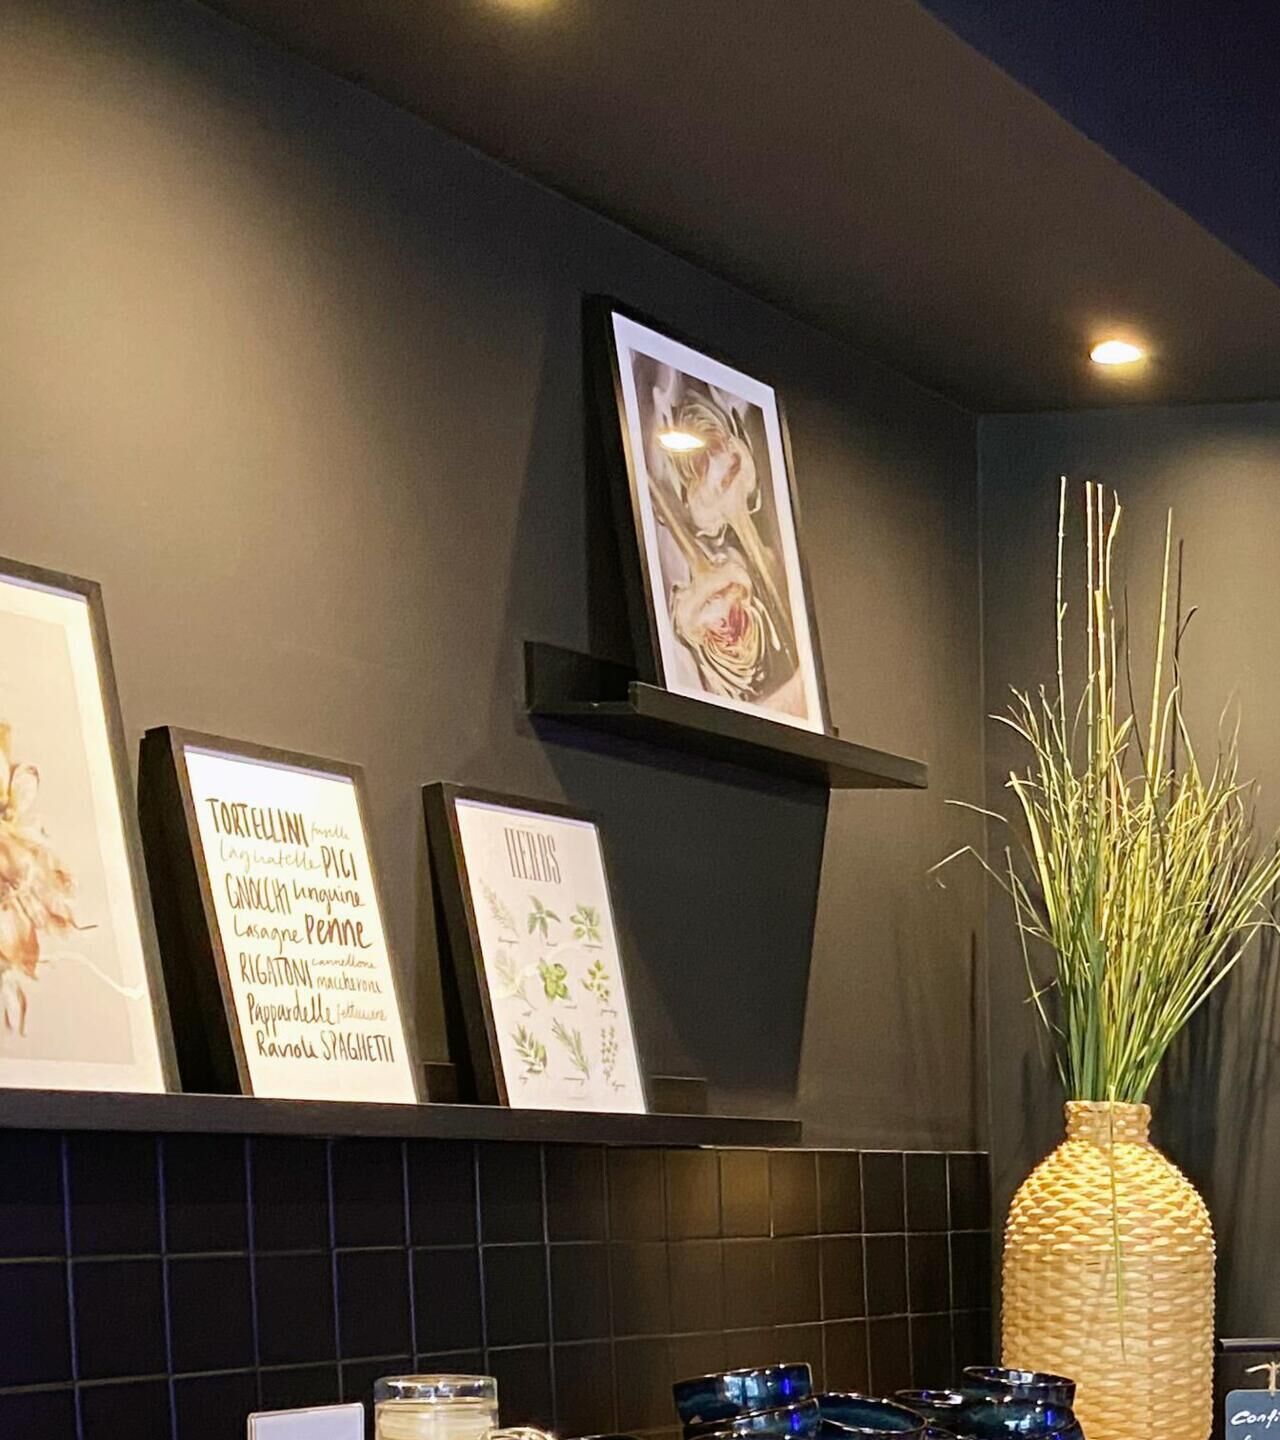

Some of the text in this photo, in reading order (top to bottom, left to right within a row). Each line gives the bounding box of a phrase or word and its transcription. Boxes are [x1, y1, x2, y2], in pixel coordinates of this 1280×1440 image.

[205, 798, 309, 848] TORTELLINI
[320, 845, 357, 880] PICI
[503, 827, 562, 885] HERBS
[225, 872, 293, 915] GNOCCHI
[304, 913, 373, 949] Penne
[239, 952, 312, 989] RIGATONI
[246, 989, 336, 1037] Pappardelle
[319, 1029, 395, 1063] SPAGHETTI
